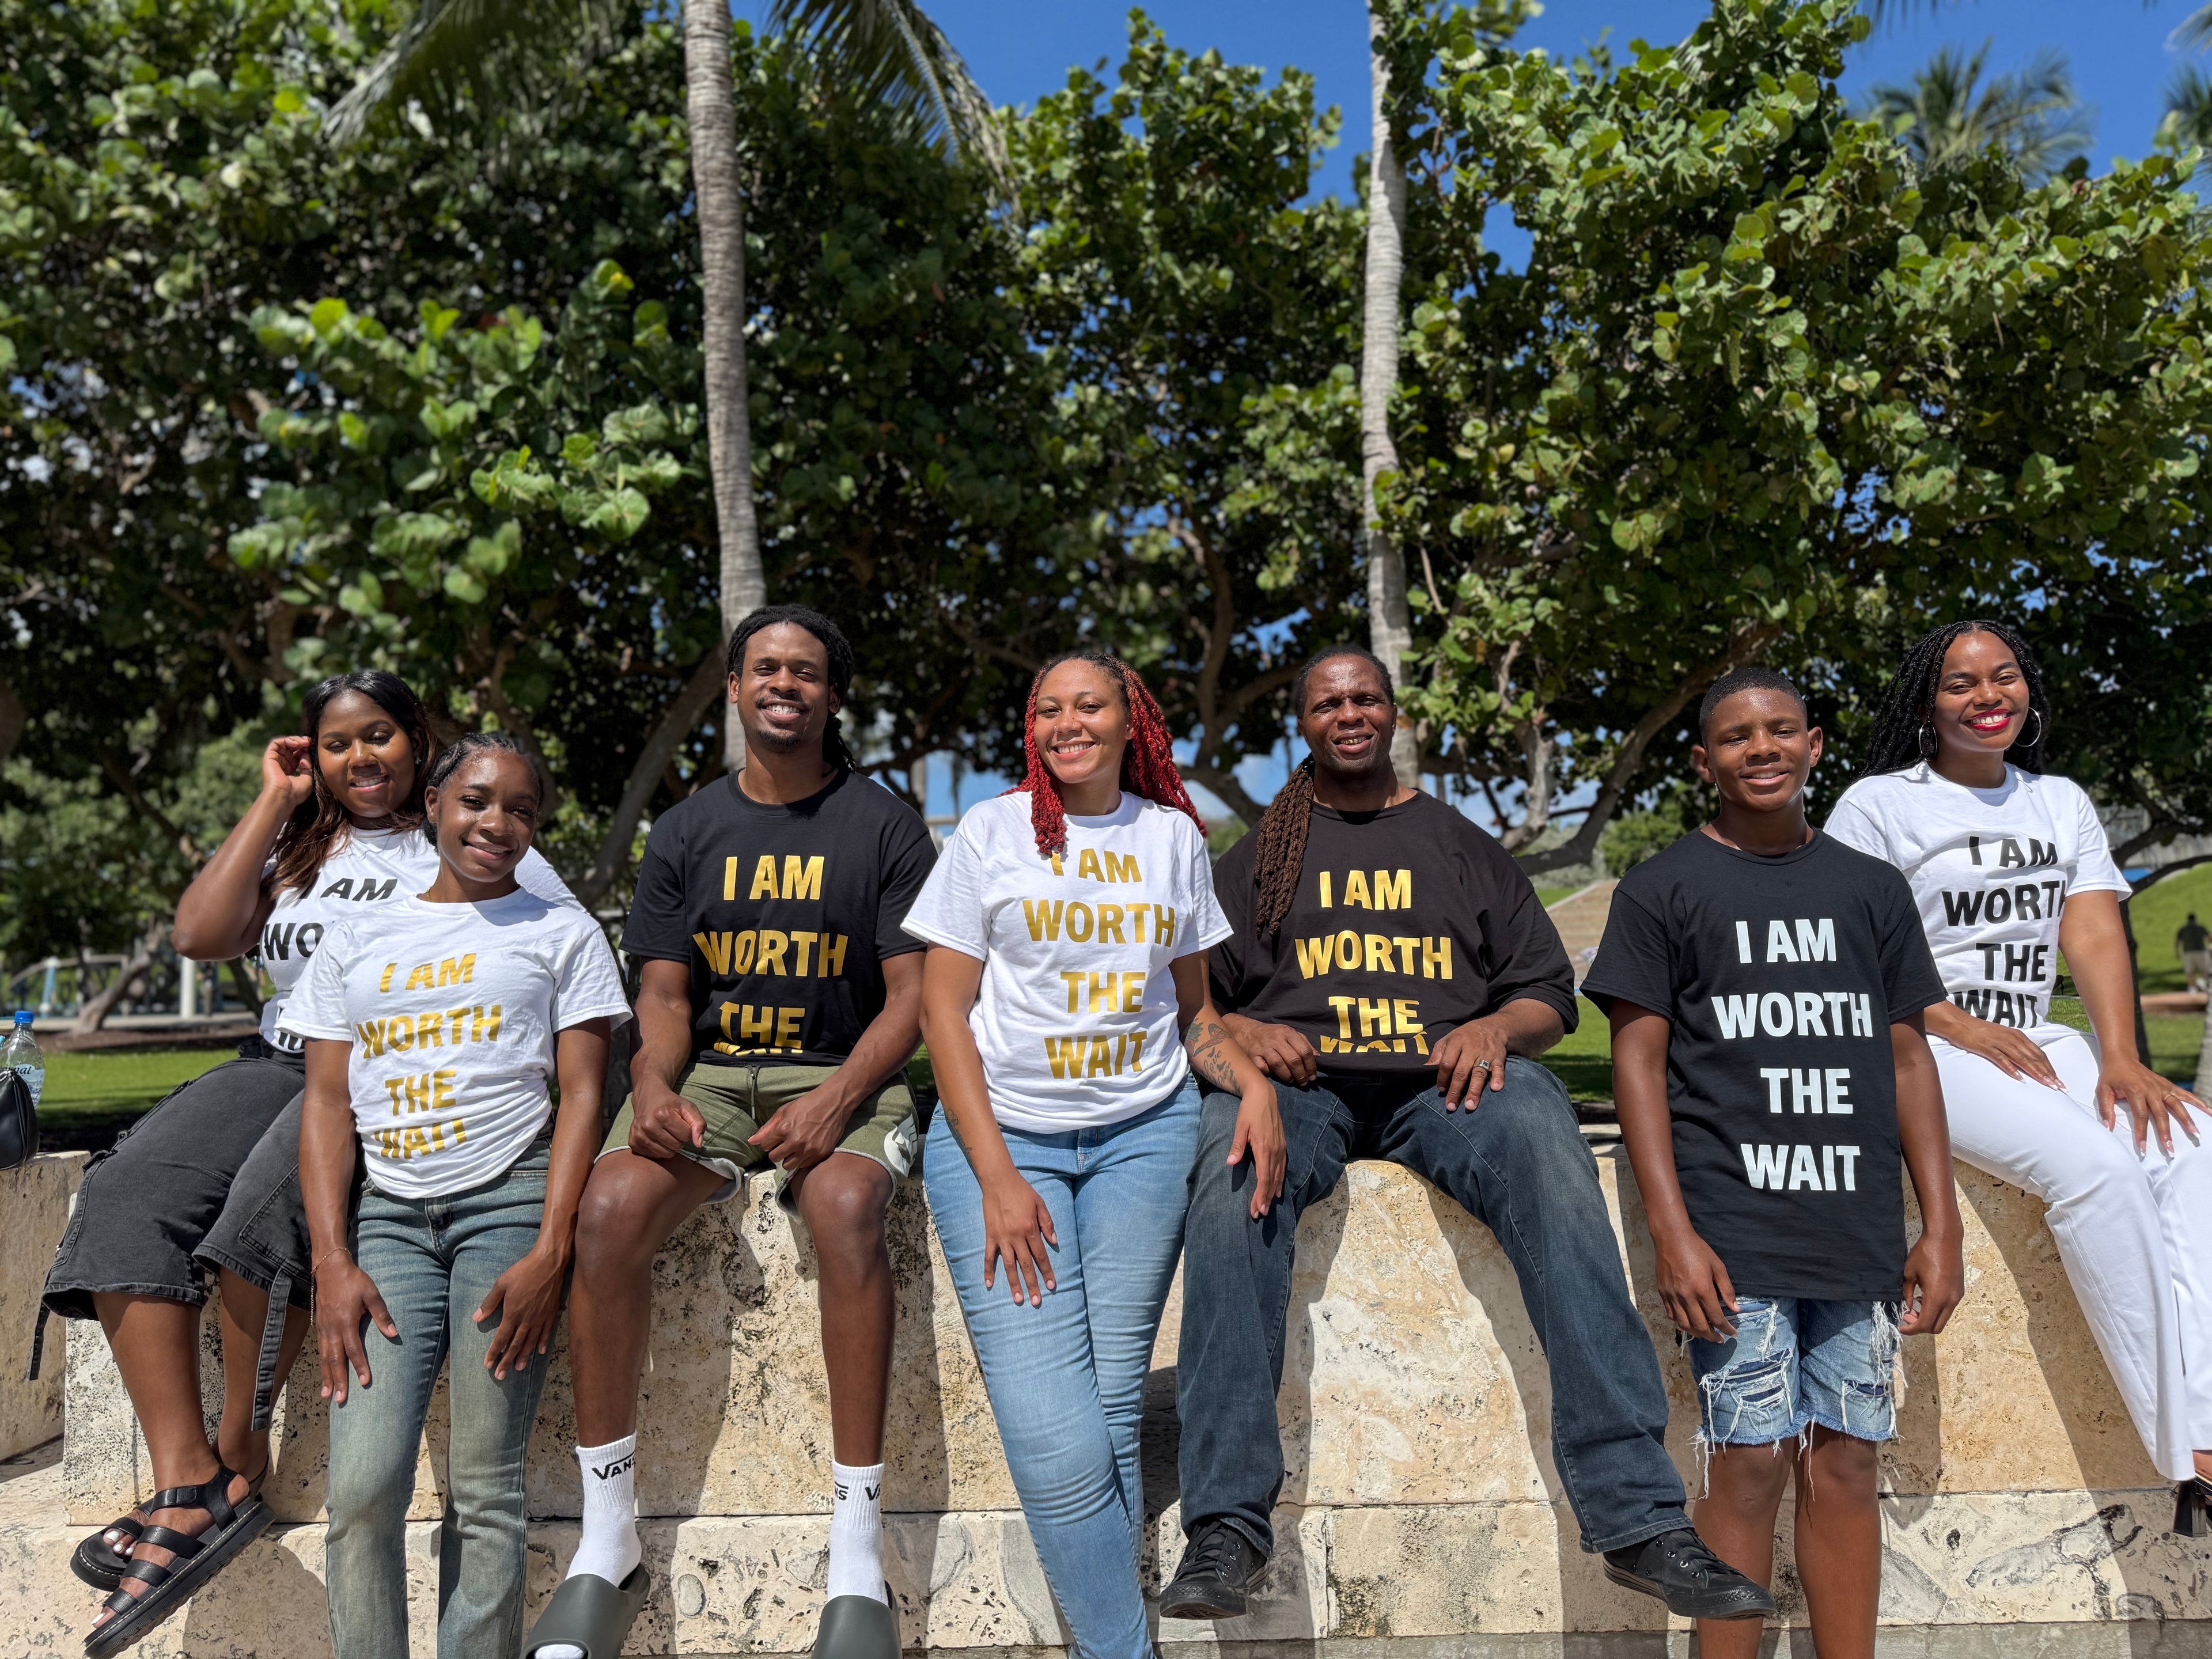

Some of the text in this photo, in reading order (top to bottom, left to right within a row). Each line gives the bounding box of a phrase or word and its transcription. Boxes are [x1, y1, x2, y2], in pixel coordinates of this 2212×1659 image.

[1078, 849, 1142, 883] AM
[1969, 836, 2058, 868] I AM
[320, 877, 397, 901] AM
[724, 855, 824, 900] I AM
[1319, 869, 1411, 910] I AM
[1022, 900, 1175, 948] WORTH
[1736, 918, 1836, 964] I AM
[379, 953, 476, 993] I AM
[692, 929, 849, 978] WORTH
[1294, 930, 1453, 979] WORTH
[1976, 943, 2049, 982] THE
[1060, 972, 1146, 1013] THE
[1711, 992, 1873, 1039] WORTH
[1953, 988, 2037, 1028] WAIT
[357, 1005, 502, 1059] WORTH
[719, 1001, 805, 1049] THE
[1328, 996, 1423, 1039] THE
[1044, 1031, 1147, 1079] WAIT
[385, 1070, 456, 1116] THE
[1760, 1067, 1853, 1114] THE
[1740, 1143, 1861, 1191] WAIT
